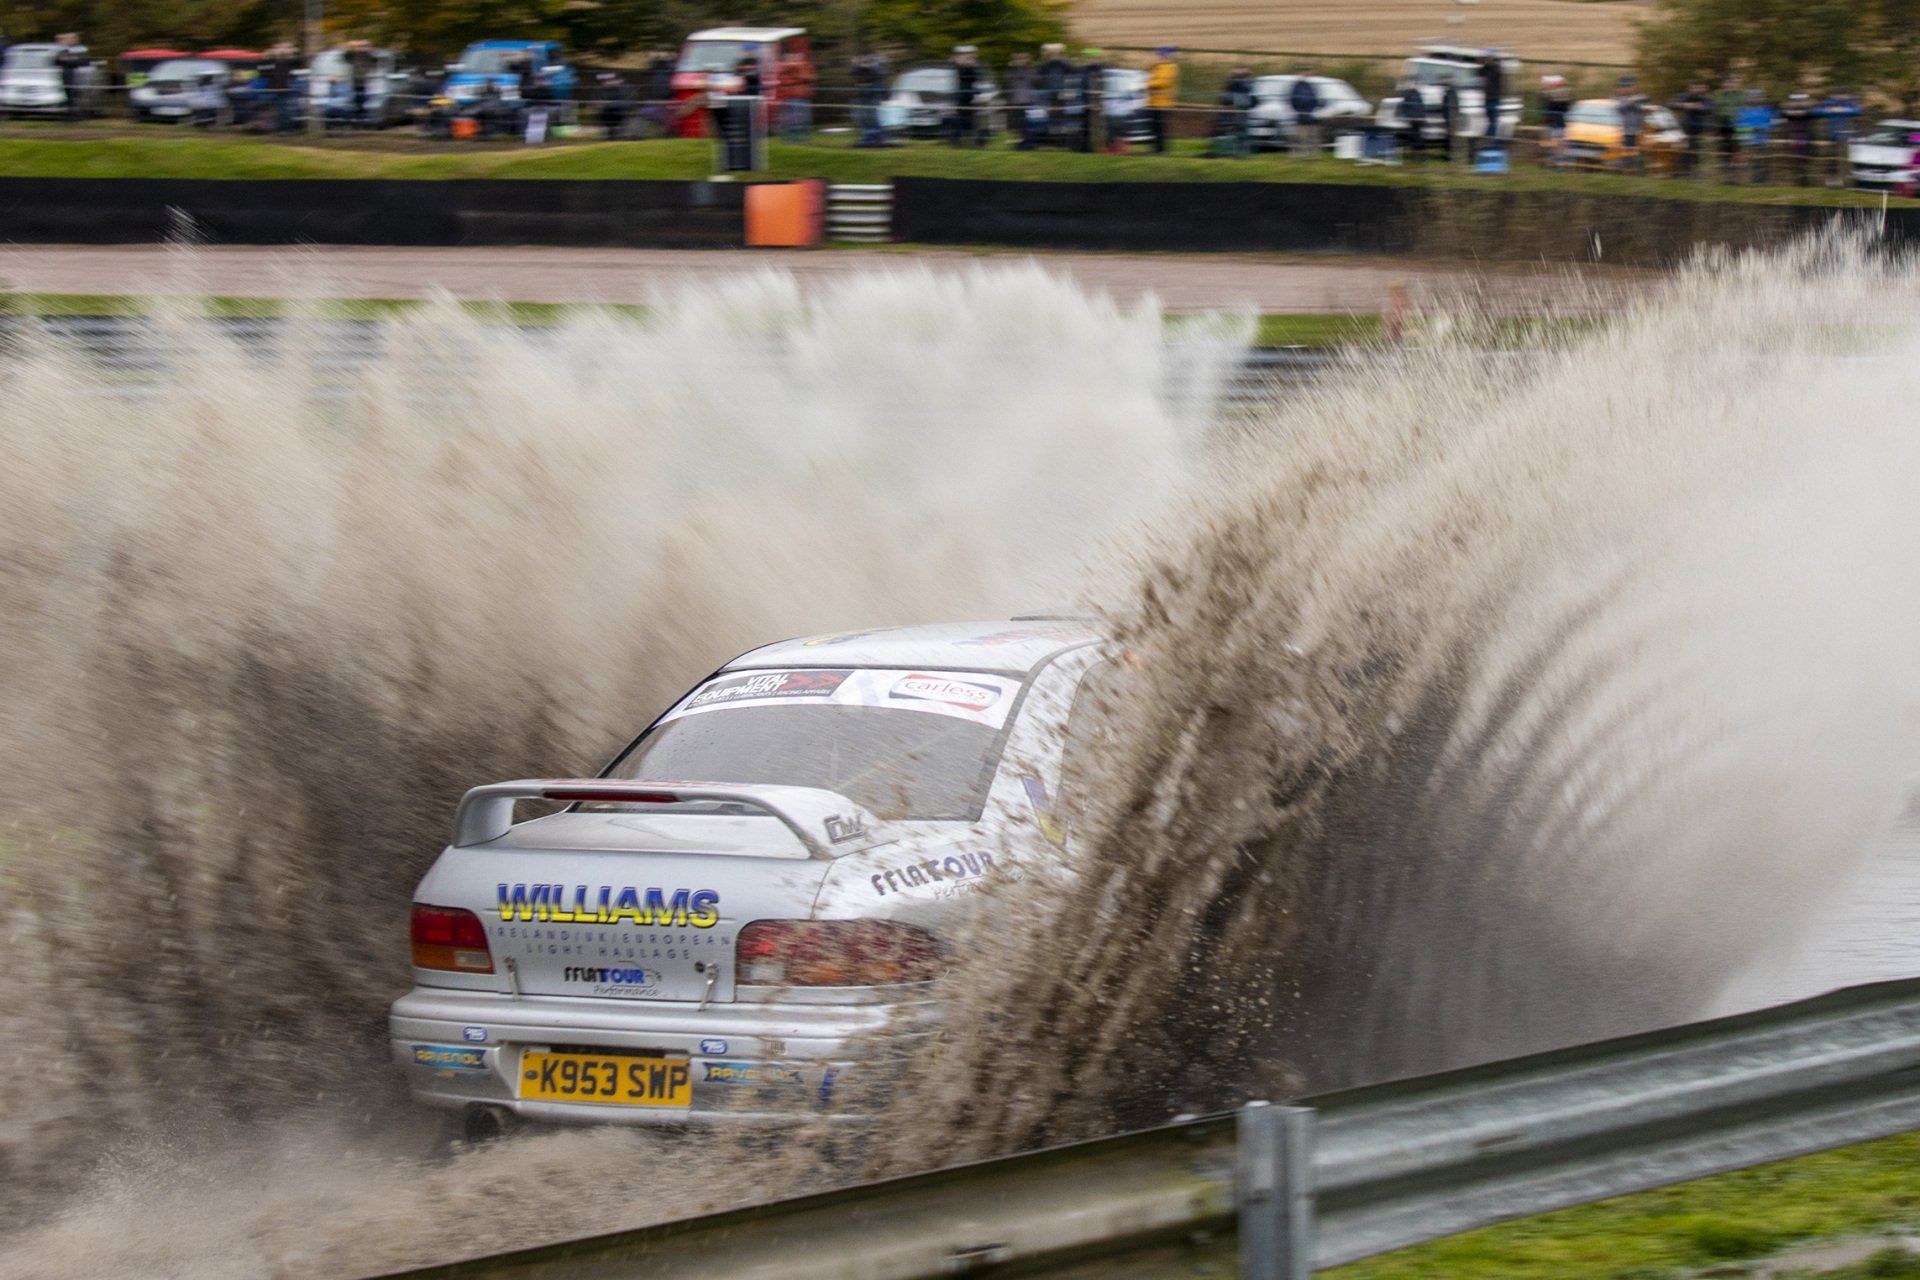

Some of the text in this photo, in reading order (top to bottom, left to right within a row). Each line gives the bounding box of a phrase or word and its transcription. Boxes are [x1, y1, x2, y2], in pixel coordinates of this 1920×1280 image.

[747, 673, 790, 686] VITAL
[693, 682, 784, 704] EQUIPMENT
[904, 680, 987, 701] carless
[497, 883, 719, 928] WILLIAMS
[526, 943, 691, 960] LIGHT HAULAGE
[540, 1060, 688, 1100] K953 SWP
